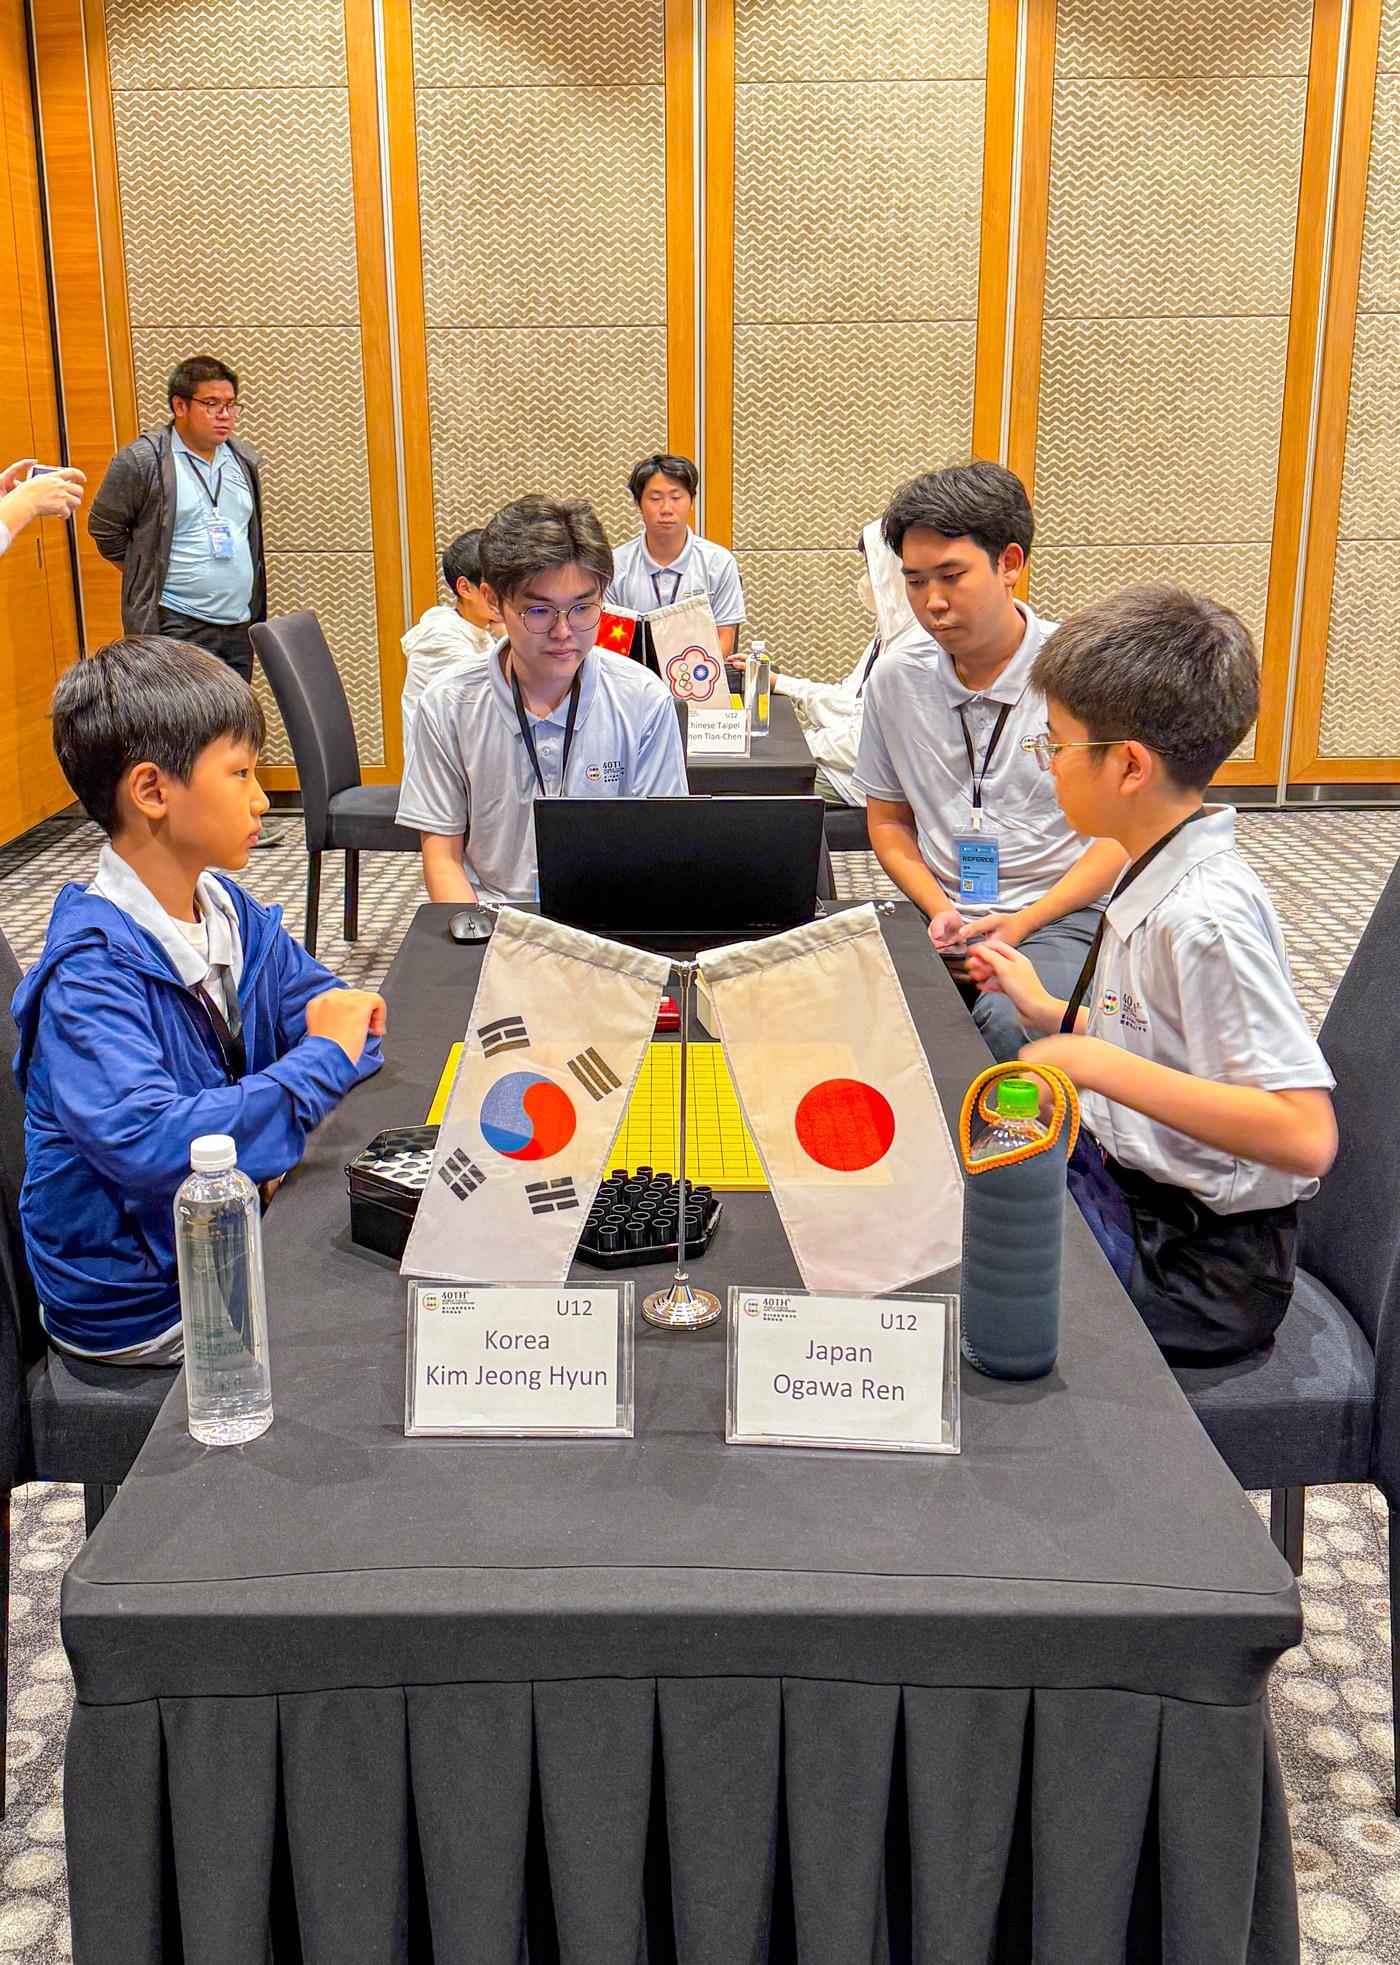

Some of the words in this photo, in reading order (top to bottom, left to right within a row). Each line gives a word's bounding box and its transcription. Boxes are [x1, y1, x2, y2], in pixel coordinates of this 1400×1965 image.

[717, 722, 740, 730] Taipei
[704, 732, 742, 740] Tian-Chen
[962, 856, 995, 864] REFEREE
[442, 1291, 466, 1299] 40TH
[763, 1298, 788, 1306] 40TH
[557, 1300, 592, 1316] U12
[881, 1313, 917, 1331] U12
[485, 1330, 550, 1350] Korea
[806, 1340, 872, 1365] Japan
[426, 1365, 468, 1386] Kim
[475, 1365, 542, 1390] Jeong
[550, 1366, 607, 1390] Hyun
[774, 1374, 851, 1400] Ogawa
[862, 1379, 905, 1401] Ren
